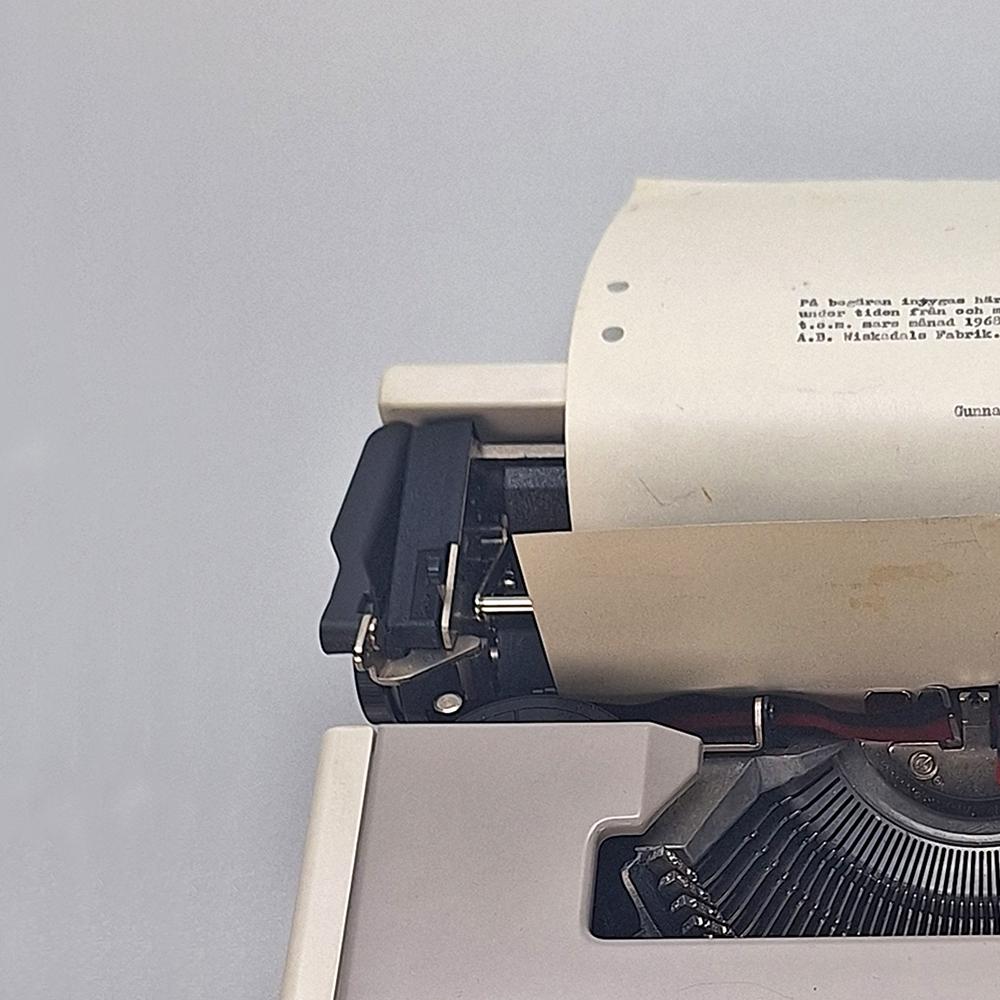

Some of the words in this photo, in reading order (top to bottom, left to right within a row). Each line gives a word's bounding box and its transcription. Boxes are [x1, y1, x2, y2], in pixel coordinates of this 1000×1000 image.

[799, 298, 819, 308] På
[798, 309, 846, 319] under
[854, 307, 900, 318] tiden
[909, 305, 947, 317] från
[954, 306, 984, 316] och
[861, 320, 900, 329] mars
[908, 317, 956, 328] månad
[935, 328, 1000, 340] Fabrik.
